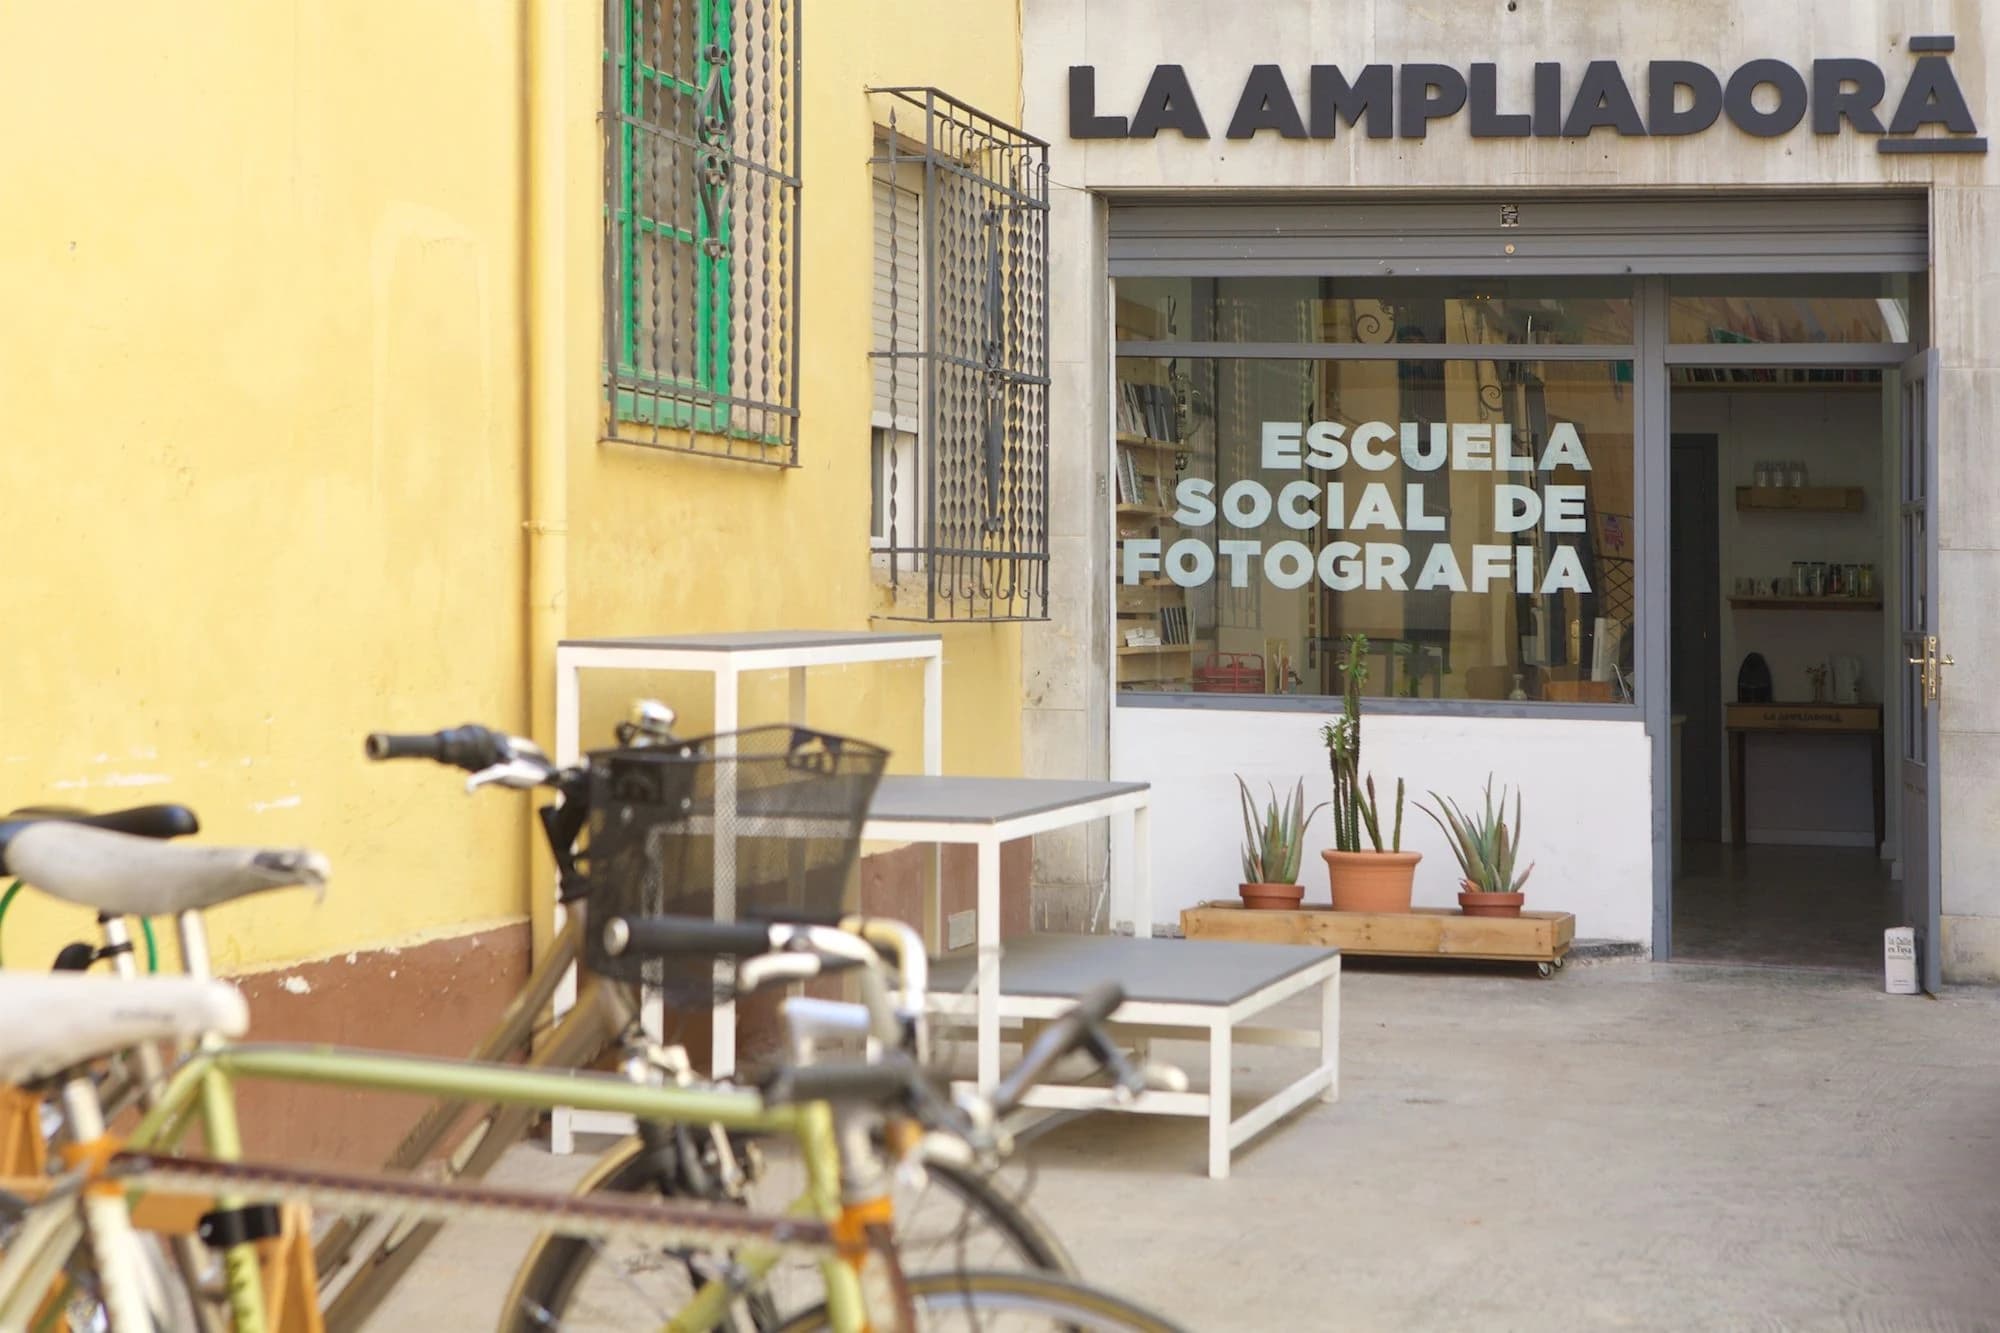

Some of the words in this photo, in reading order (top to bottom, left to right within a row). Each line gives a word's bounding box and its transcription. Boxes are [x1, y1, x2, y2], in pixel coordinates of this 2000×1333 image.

[1070, 65, 1209, 140] LA
[1227, 36, 1988, 154] AMPLIADORA
[1262, 421, 1593, 471] ESCUELA
[1173, 478, 1446, 532] SOCIAL
[1494, 485, 1587, 533] DE
[1122, 538, 1592, 595] FOTOGRAFIA
